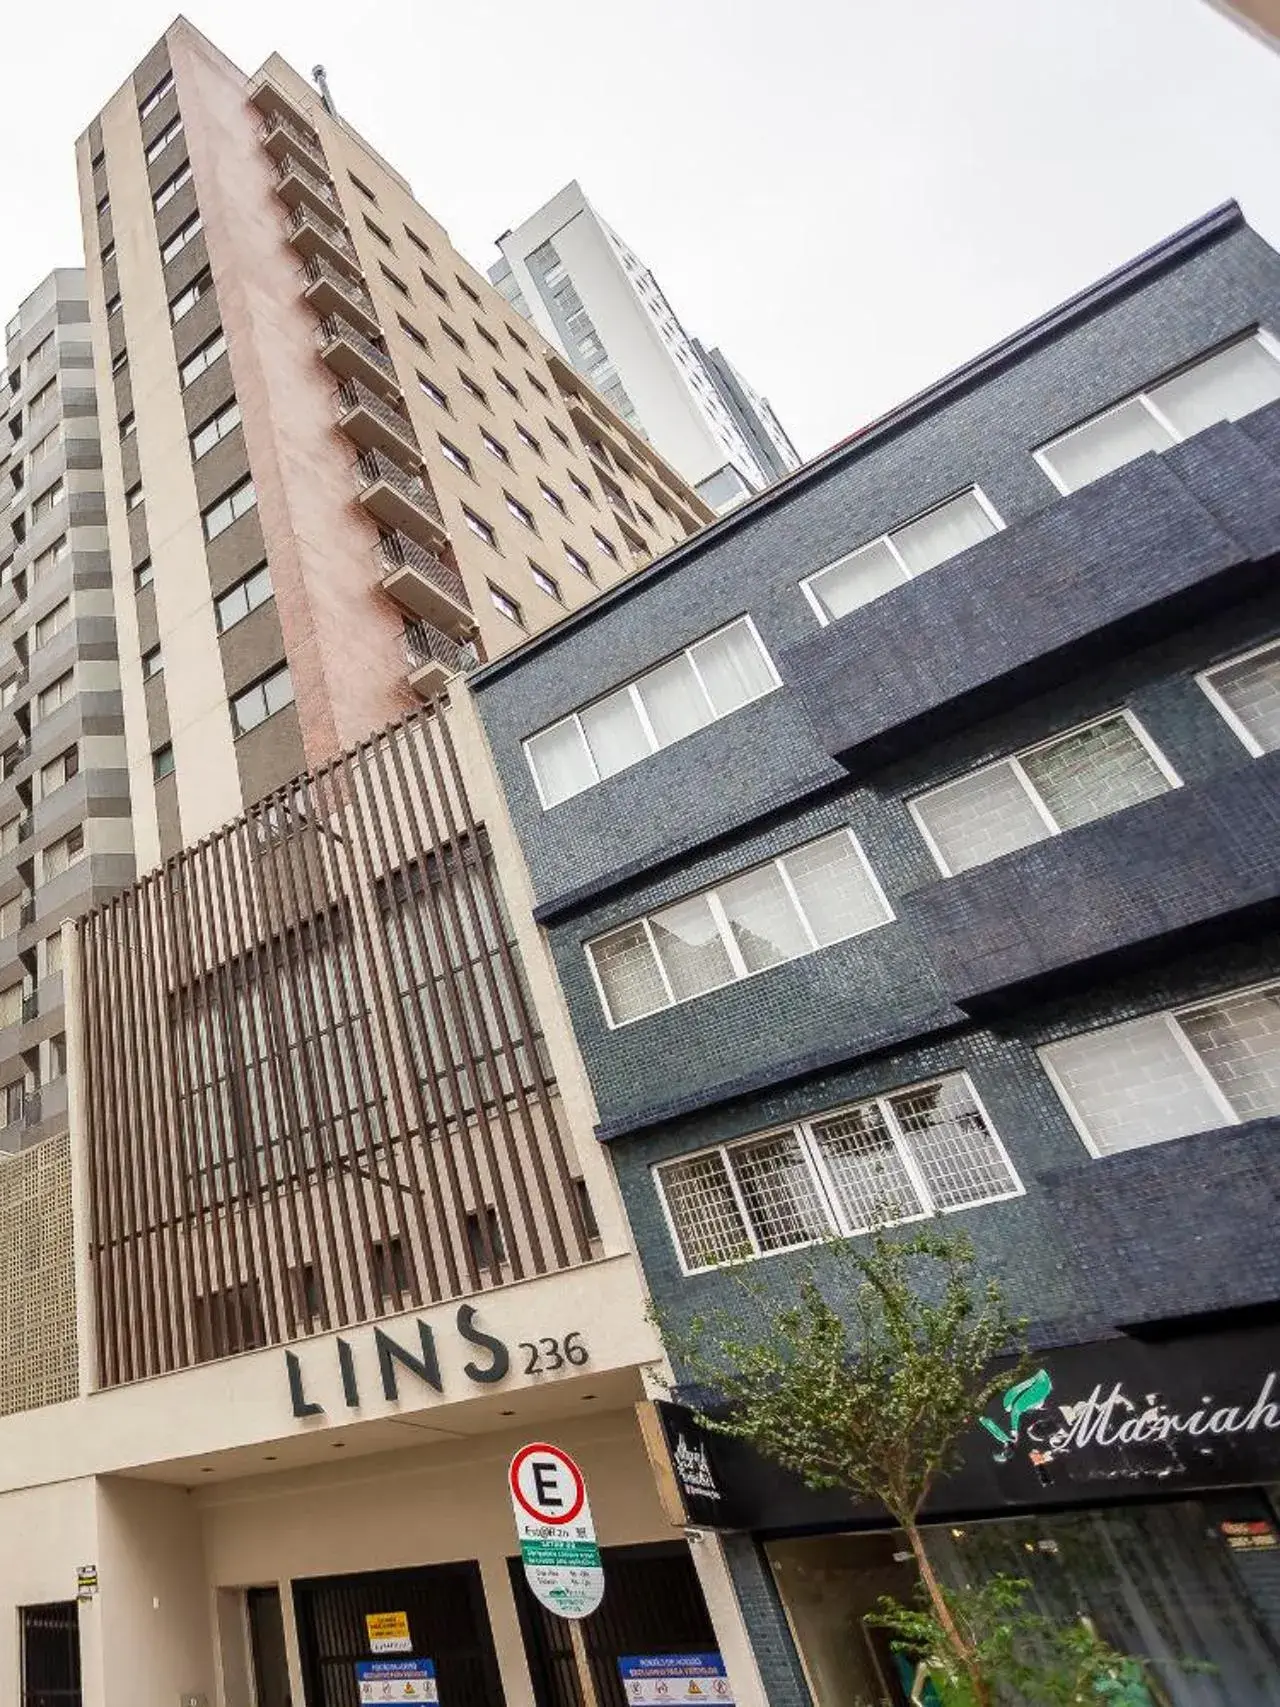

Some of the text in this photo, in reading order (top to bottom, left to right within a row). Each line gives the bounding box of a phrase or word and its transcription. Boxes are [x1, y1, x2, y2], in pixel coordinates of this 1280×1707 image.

[285, 1303, 589, 1418] LINS 236
[1049, 1372, 1280, 1450] Mariah
[532, 1463, 563, 1506] E
